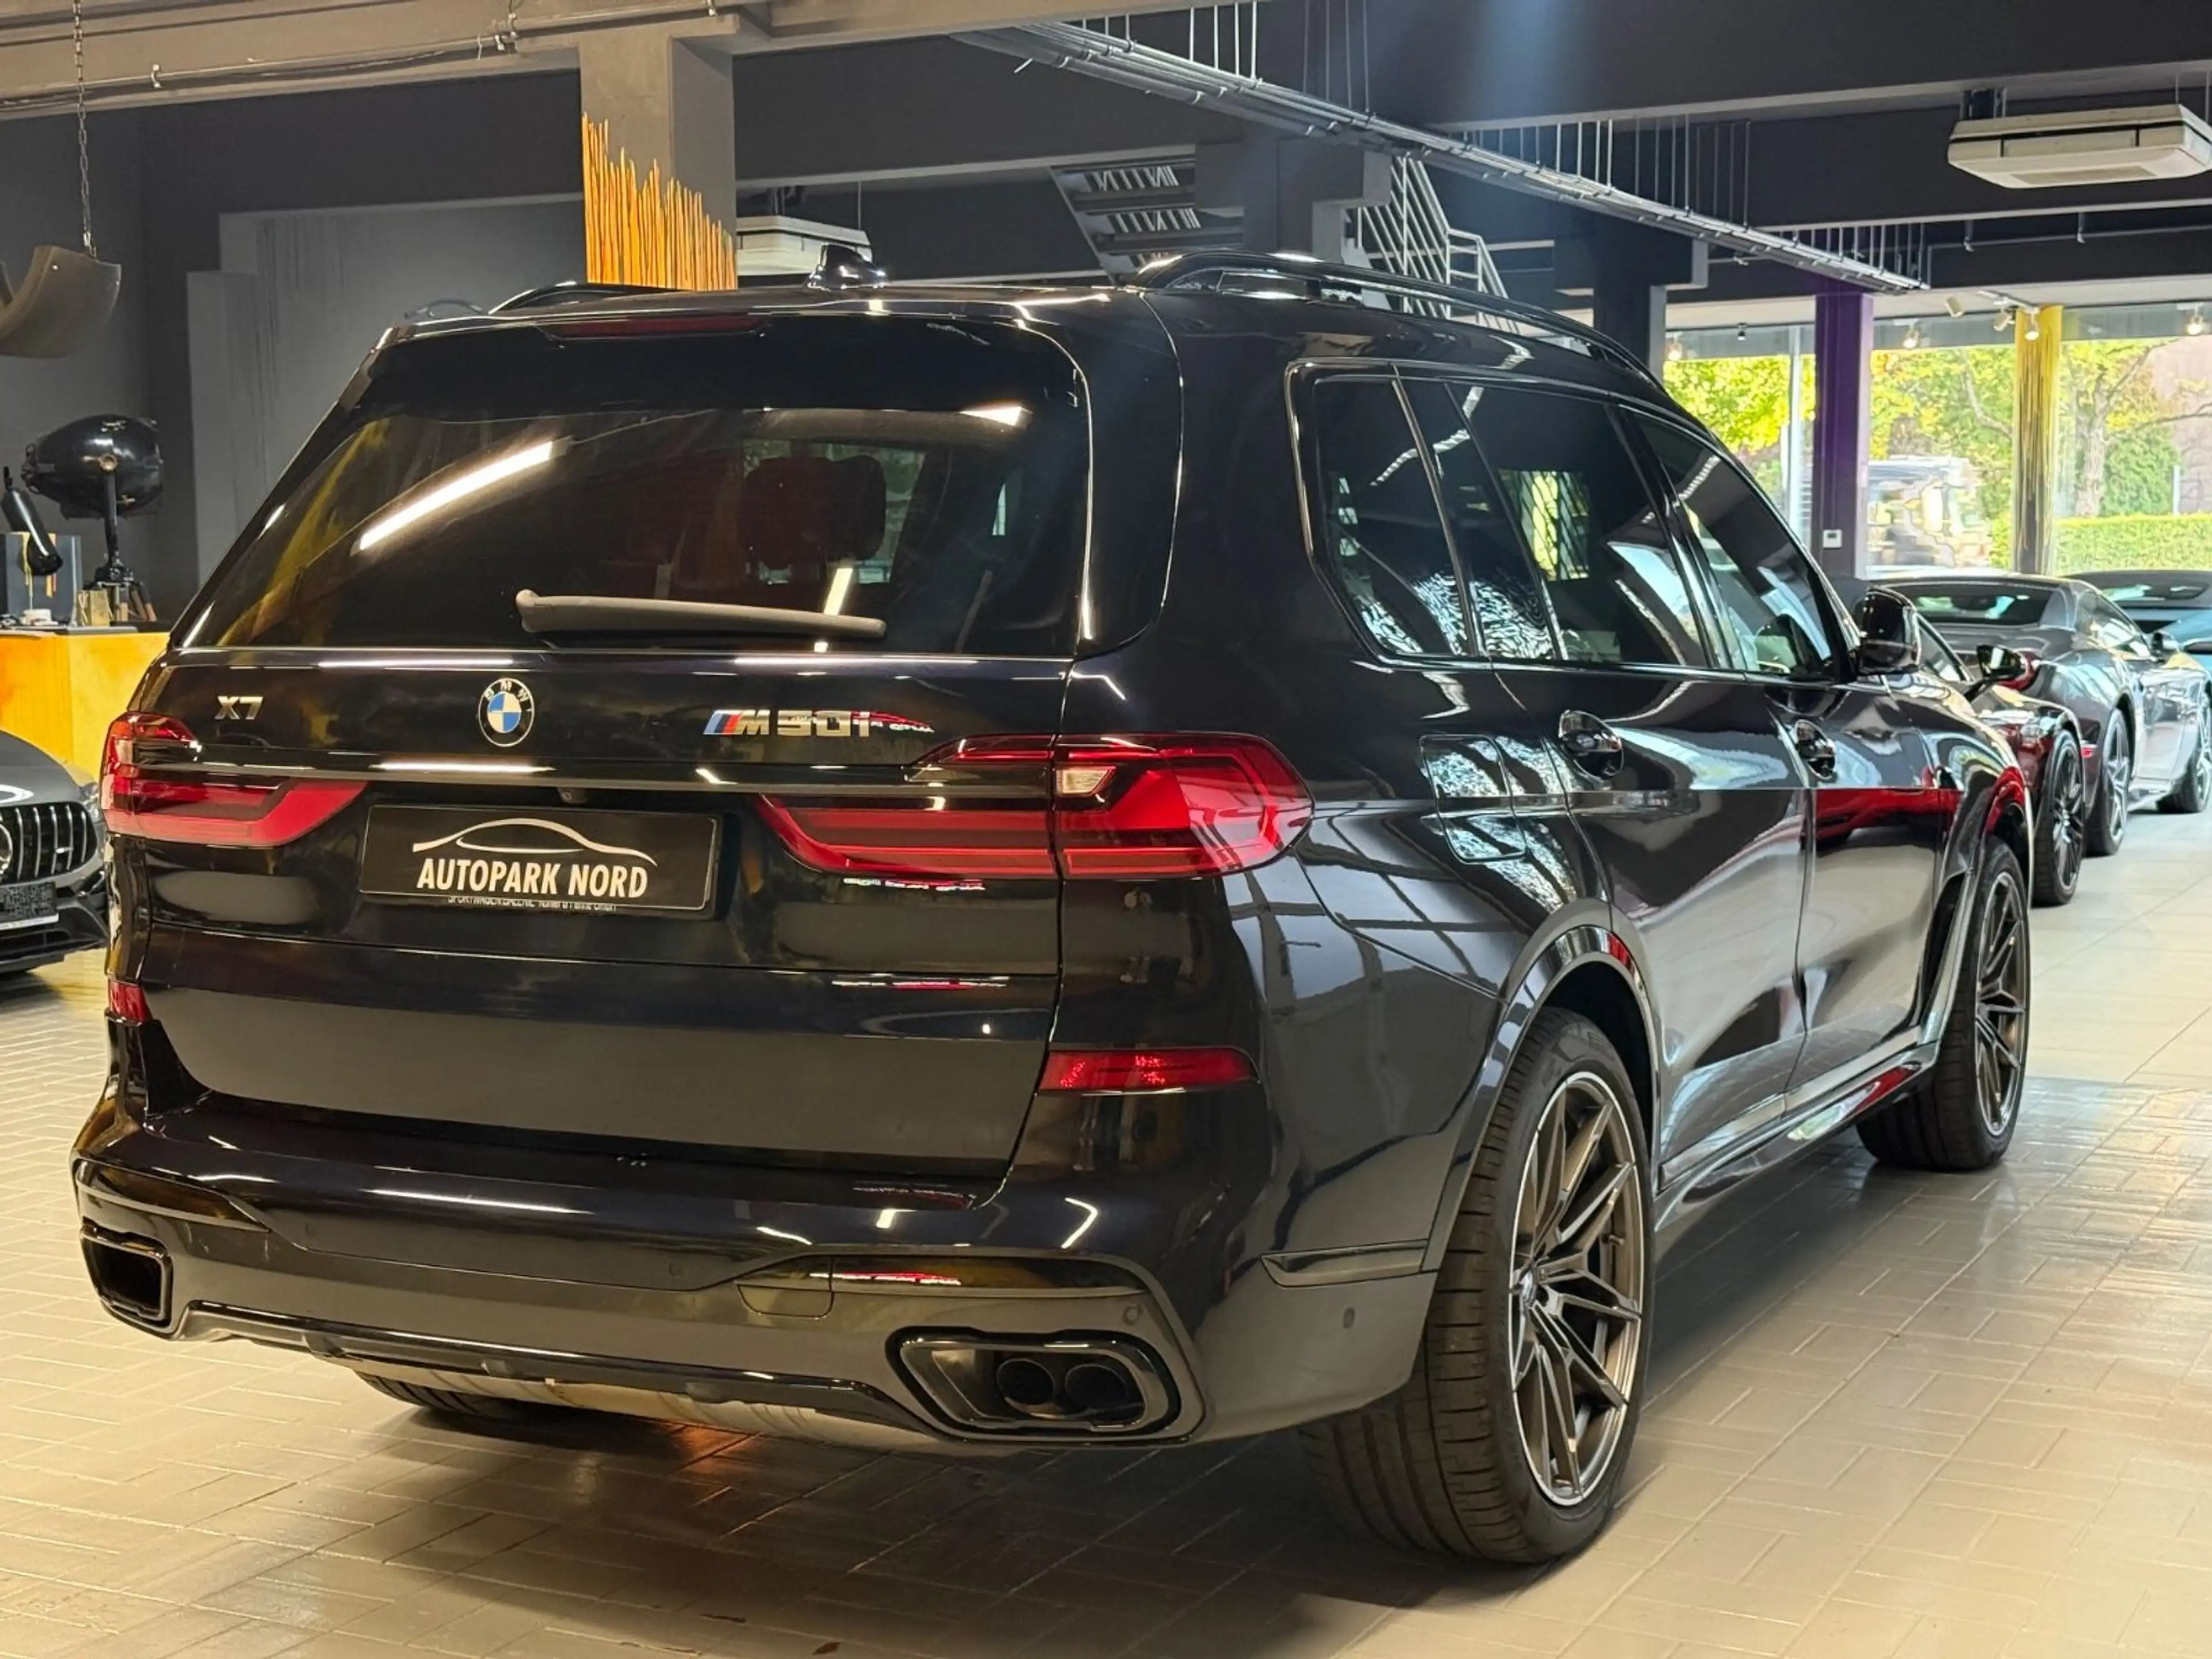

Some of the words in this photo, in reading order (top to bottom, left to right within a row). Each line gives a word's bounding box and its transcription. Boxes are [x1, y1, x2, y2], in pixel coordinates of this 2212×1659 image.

[483, 680, 531, 702] BMW
[214, 696, 263, 720] X7
[416, 858, 561, 894] AUTOPARK
[568, 863, 648, 899] NORD
